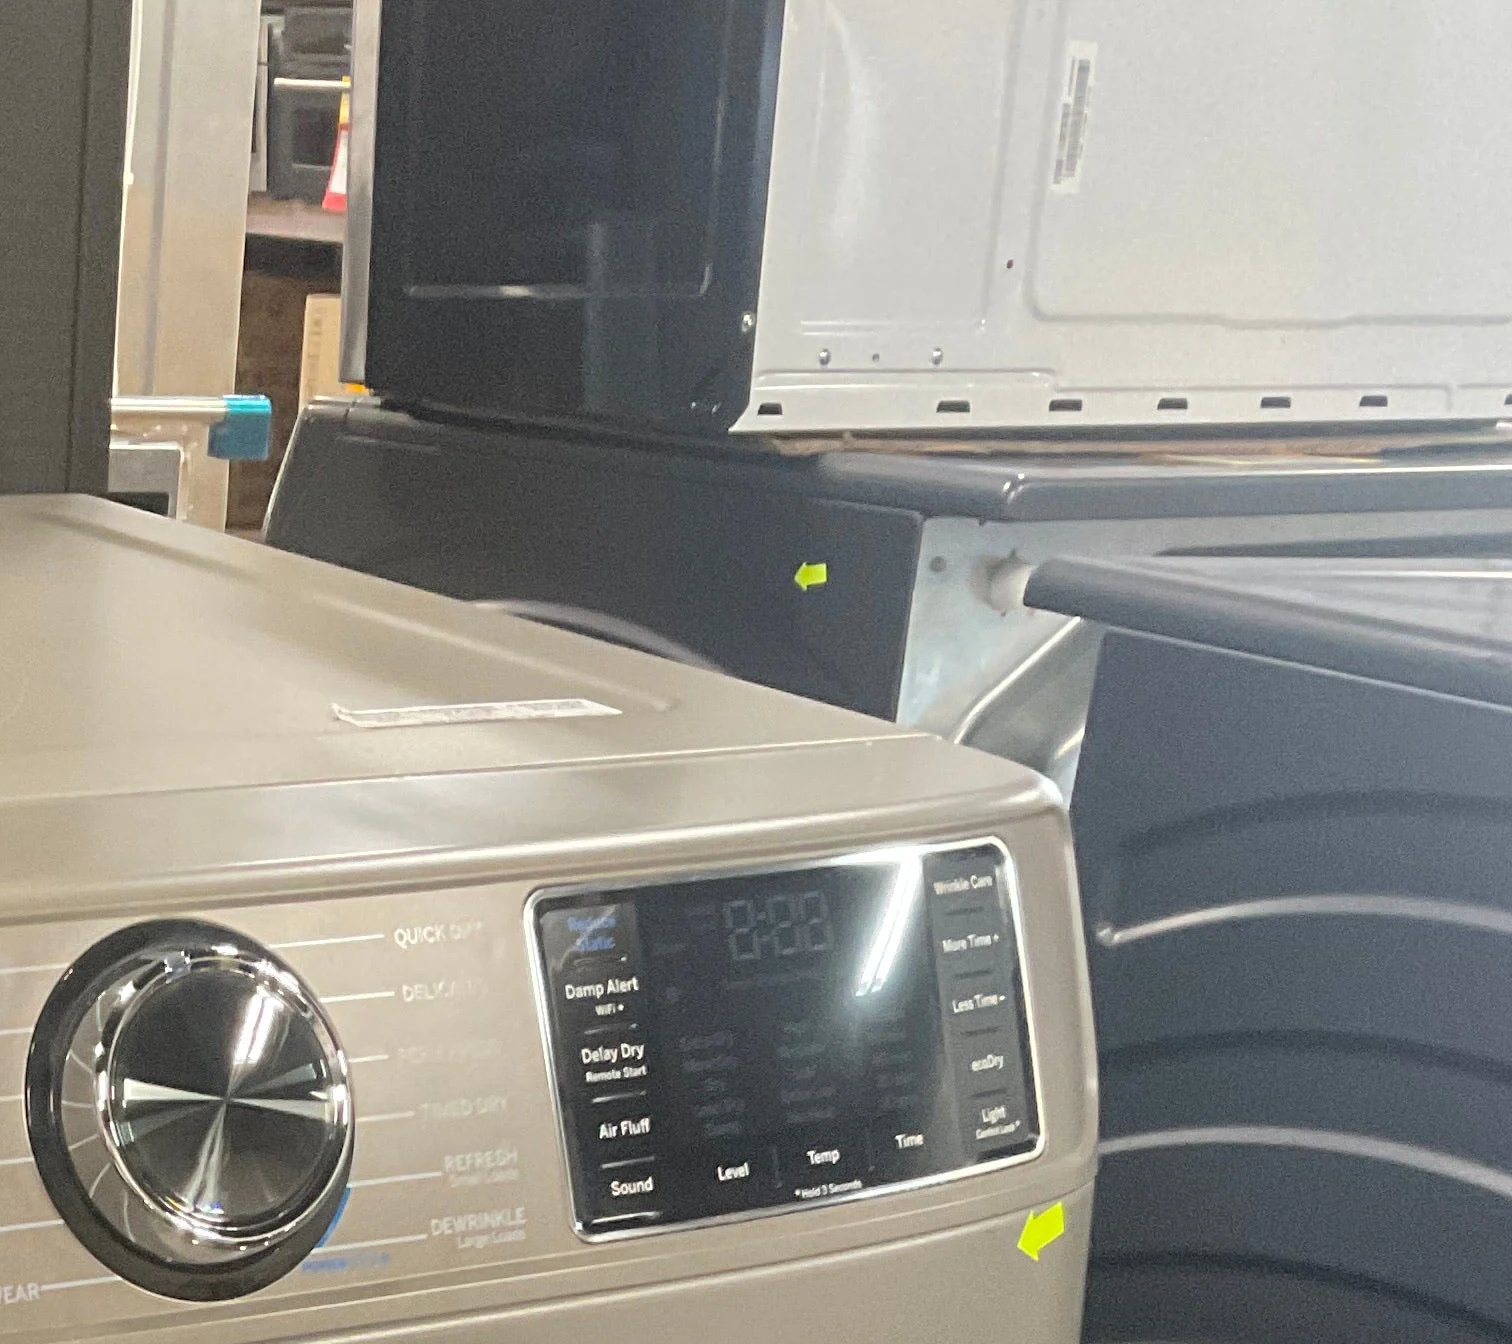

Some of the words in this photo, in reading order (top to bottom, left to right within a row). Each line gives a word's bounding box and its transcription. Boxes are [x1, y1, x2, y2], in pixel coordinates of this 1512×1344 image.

[394, 924, 445, 949] QUICK
[942, 938, 967, 953] More
[967, 933, 991, 948] Time
[565, 983, 604, 999] Damp
[607, 976, 639, 995] Alert
[951, 999, 974, 1014] Less
[973, 993, 998, 1009] Time
[581, 1046, 618, 1064] Delay
[620, 1042, 644, 1060] Dry
[585, 1070, 621, 1083] Remote
[622, 1065, 647, 1079] Start
[981, 1105, 1006, 1124] Light
[599, 1122, 618, 1139] Air
[620, 1117, 650, 1136] Fluff
[894, 1133, 924, 1149] Time
[444, 1148, 518, 1173] REFRESH
[806, 1149, 841, 1165] Temp
[717, 1162, 749, 1181] Level
[610, 1176, 654, 1196] Sound
[430, 1207, 526, 1236] DEWRINKLE
